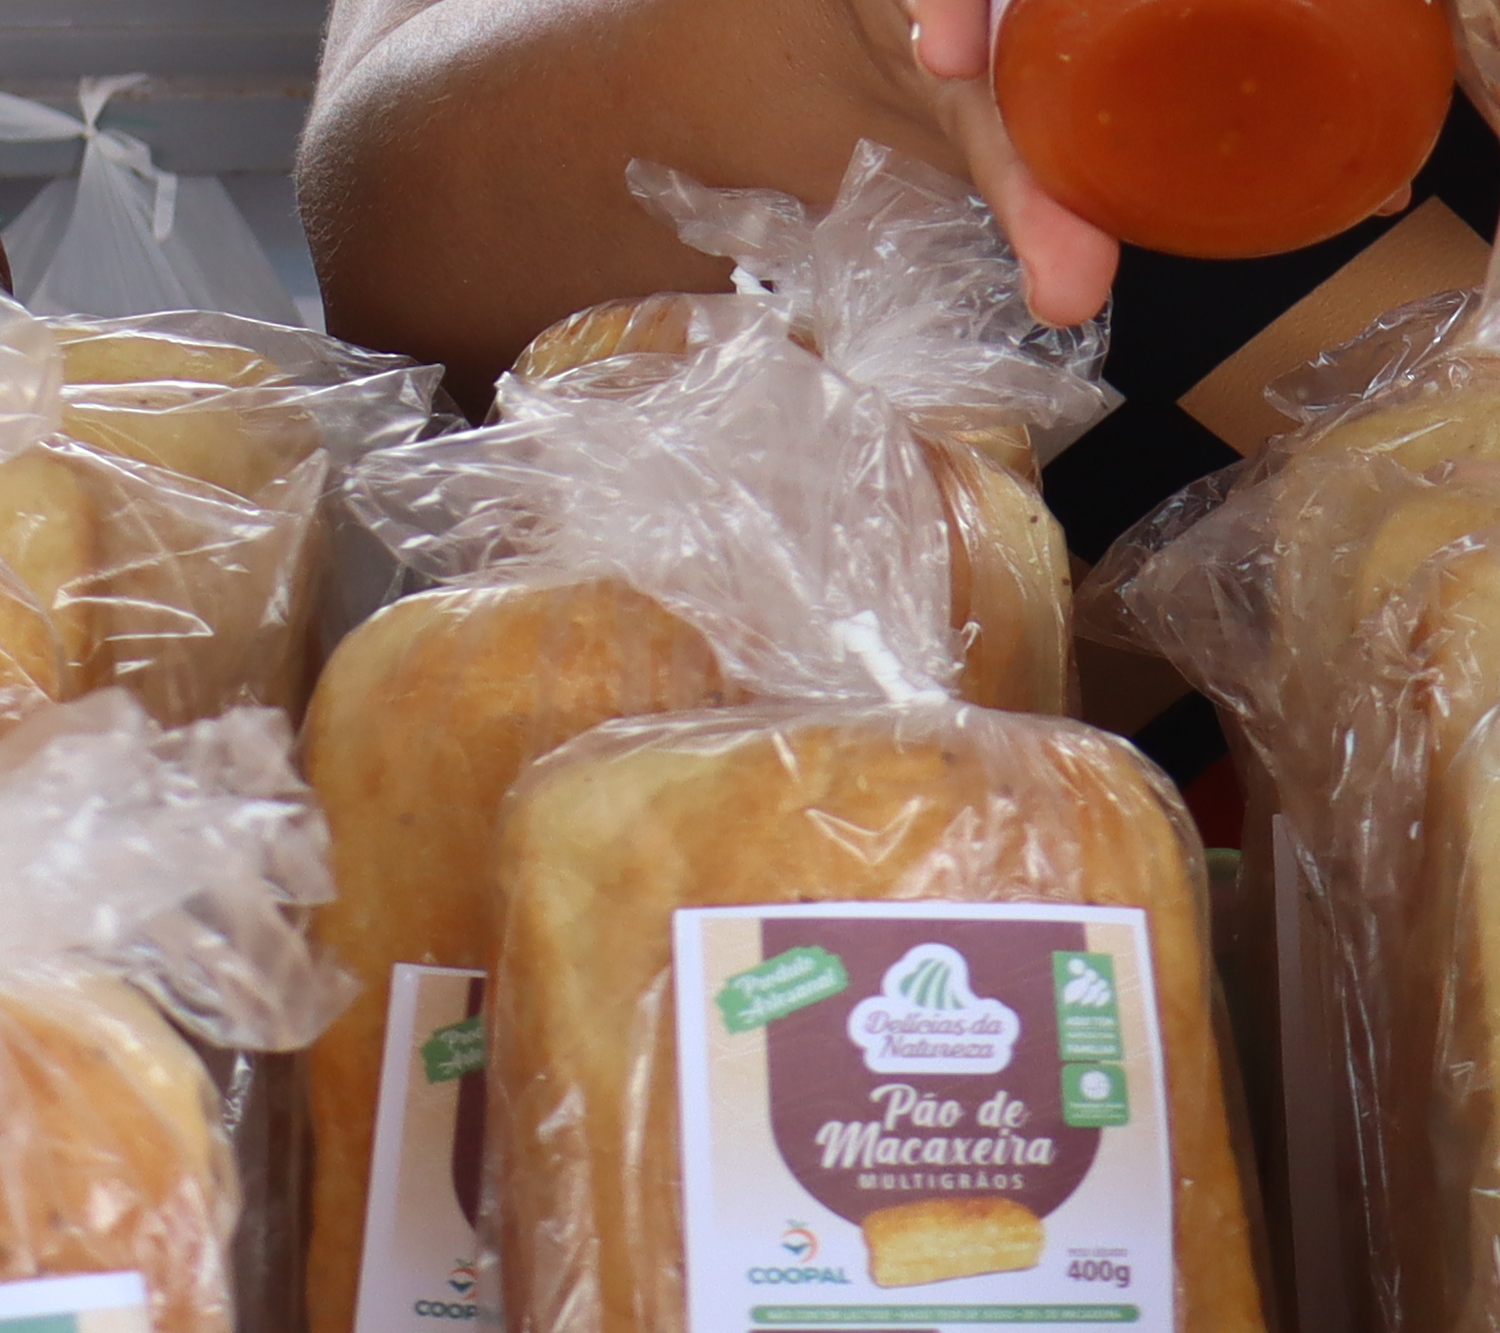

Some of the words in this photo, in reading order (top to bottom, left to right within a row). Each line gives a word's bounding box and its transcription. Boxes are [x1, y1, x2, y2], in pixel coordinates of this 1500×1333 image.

[864, 1010, 969, 1035] Delícias
[878, 1034, 995, 1059] Natureza
[869, 1082, 966, 1132] Pão
[976, 1090, 1032, 1129] de
[815, 1119, 1057, 1169] Macaxeira
[857, 1171, 1025, 1191] MULTIGRÃOS
[747, 1267, 852, 1285] COOPAL
[1066, 1259, 1131, 1289] 400g
